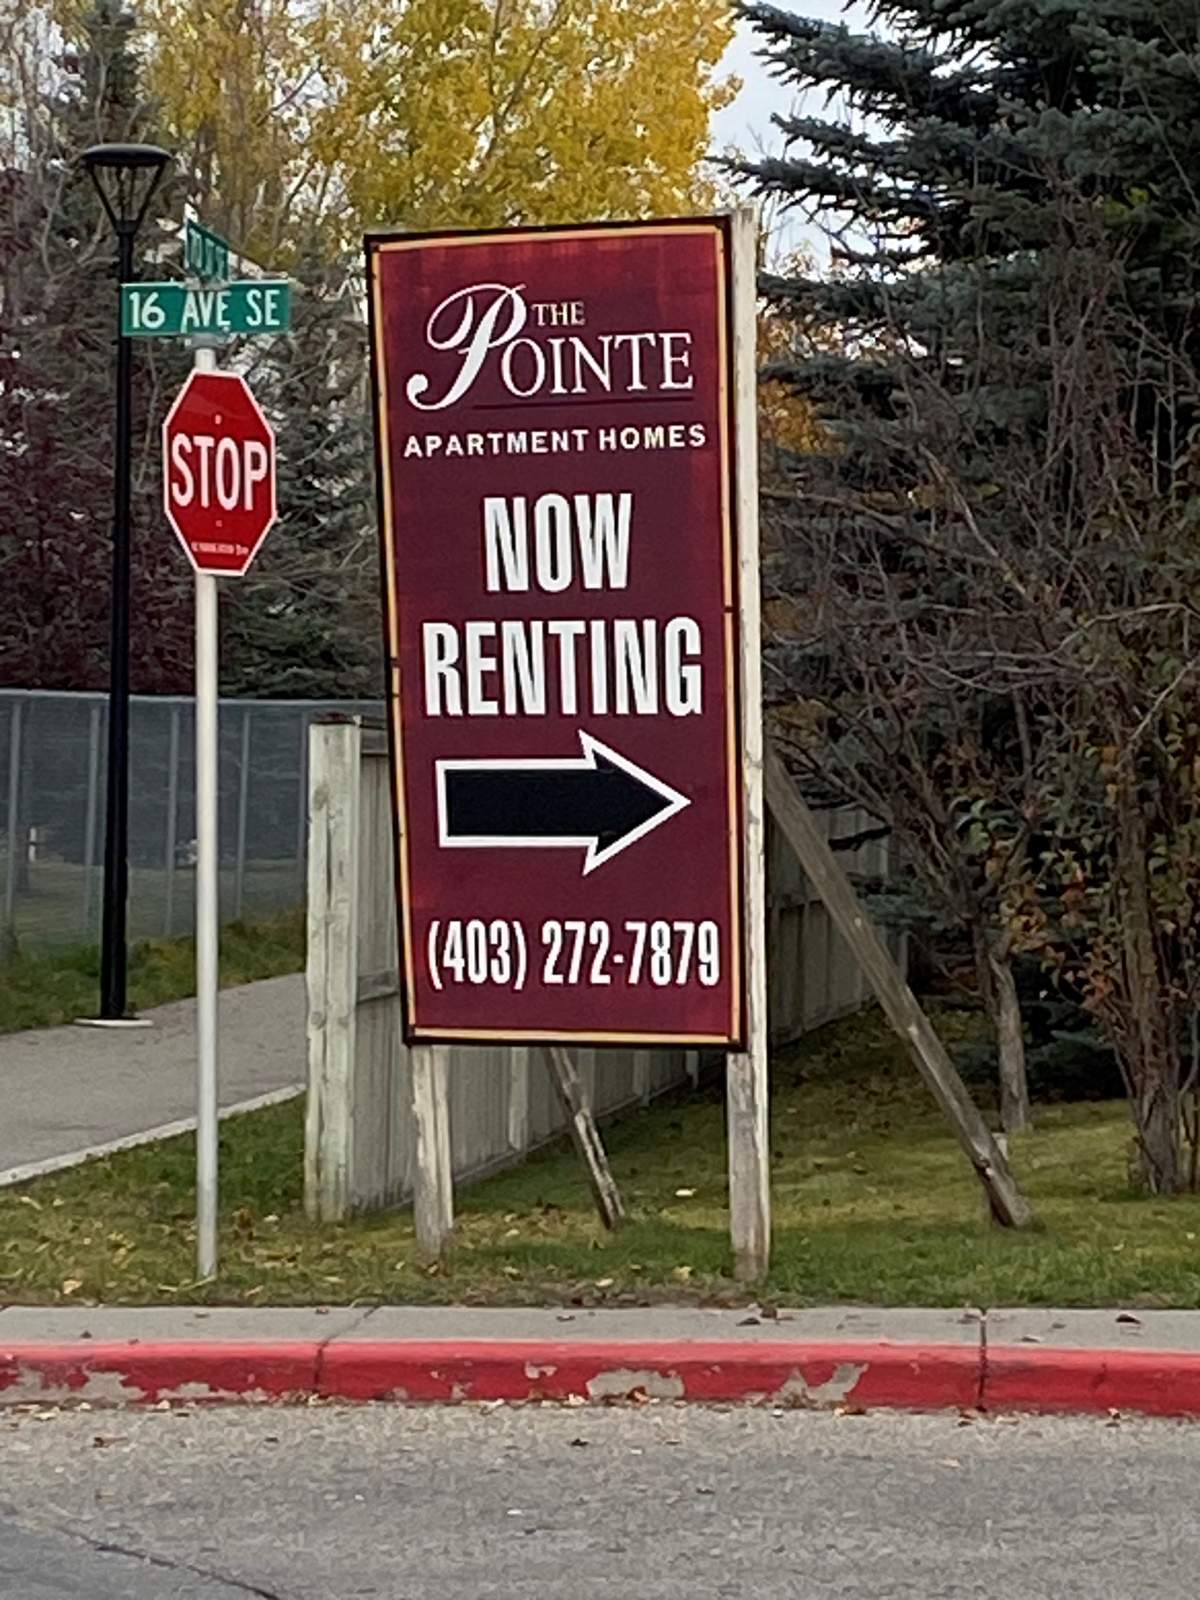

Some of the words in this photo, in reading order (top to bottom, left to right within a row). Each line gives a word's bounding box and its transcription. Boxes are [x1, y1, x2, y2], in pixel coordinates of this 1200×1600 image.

[130, 291, 165, 329] 16
[181, 291, 232, 332] AVE
[246, 289, 280, 325] SE
[406, 283, 693, 410] POINTE
[531, 301, 585, 326] THE
[171, 433, 267, 511] STOP
[403, 429, 588, 457] APARTMENT
[599, 424, 706, 450] HOMES
[484, 493, 632, 592] NOW
[422, 617, 702, 716] RENTING
[428, 919, 526, 990] (403)
[542, 920, 720, 986] 272-7879
